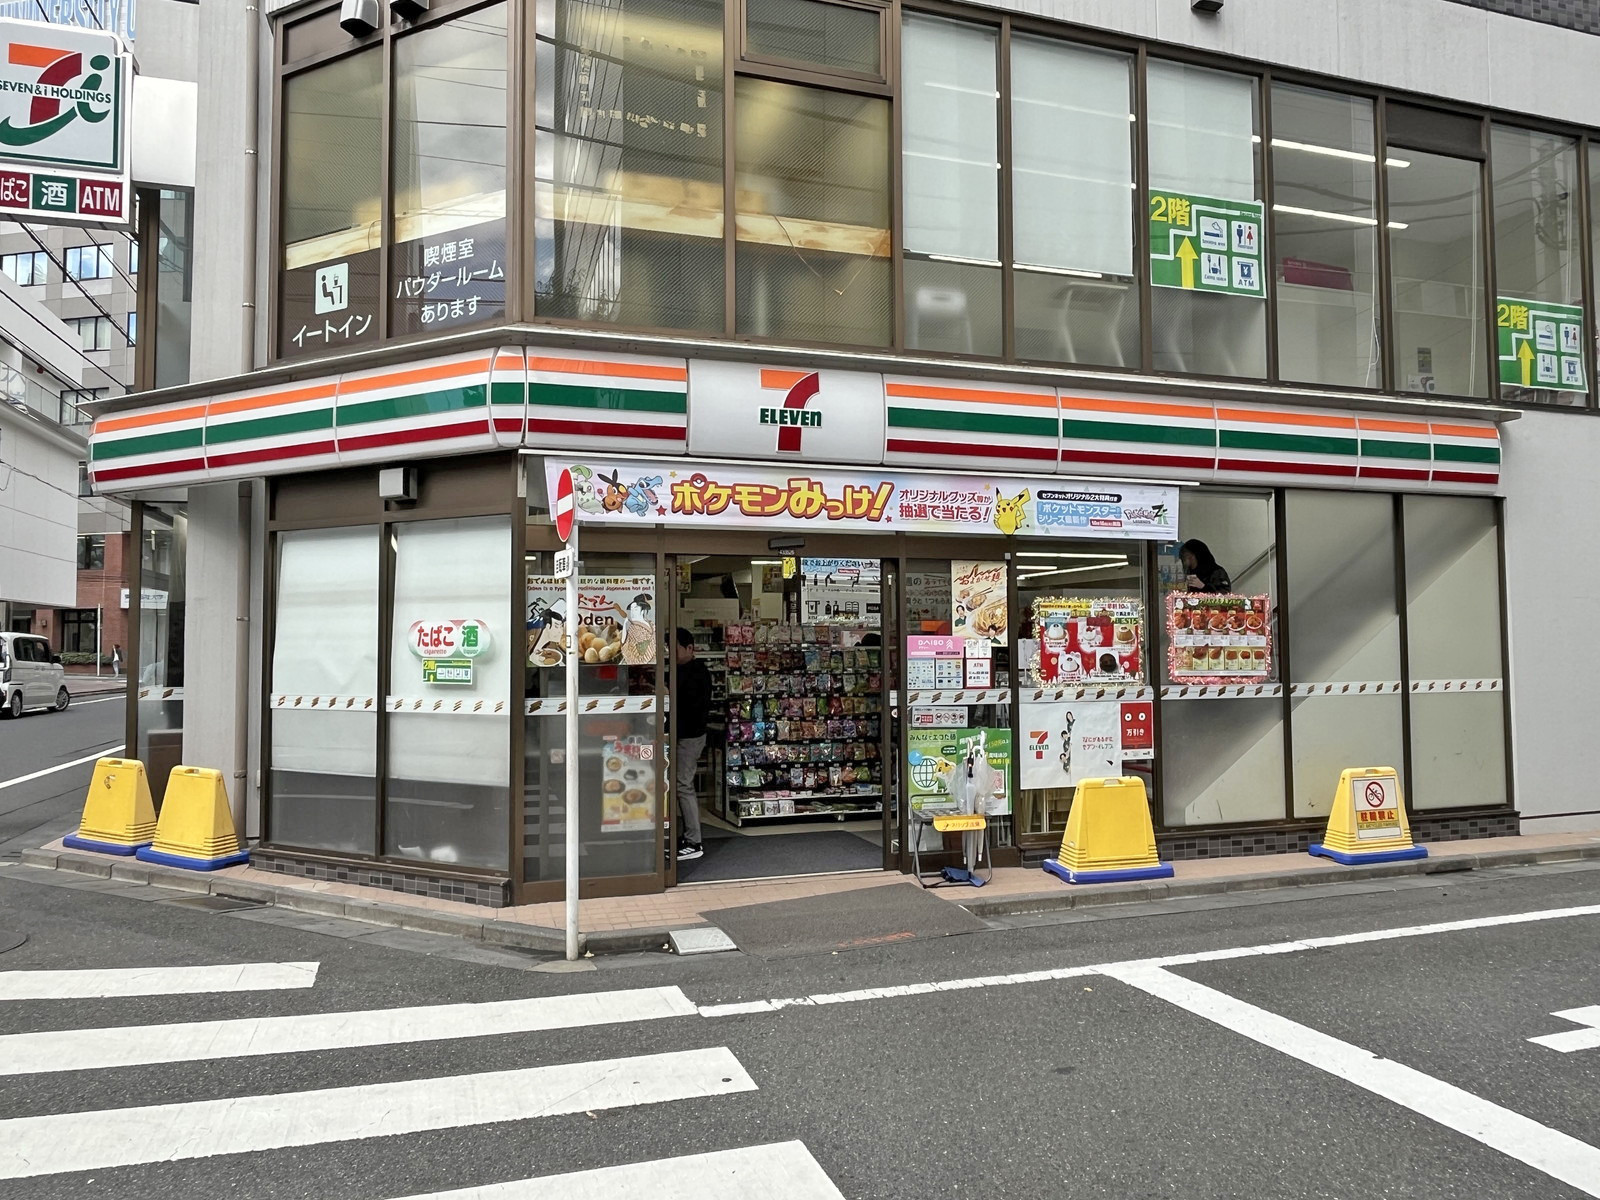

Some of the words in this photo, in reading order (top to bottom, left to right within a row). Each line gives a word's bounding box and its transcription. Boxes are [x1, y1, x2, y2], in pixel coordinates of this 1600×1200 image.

[51, 87, 111, 104] HOLDINGS
[41, 181, 68, 207] 酒
[81, 186, 120, 212] ATM
[1150, 196, 1190, 227] 2階
[424, 238, 475, 267] 喫煙室
[396, 260, 504, 299] パウダールーム
[1238, 279, 1254, 287] ATM
[420, 295, 482, 324] あります
[1498, 304, 1529, 331] 2階
[292, 314, 372, 348] イートイン
[671, 473, 895, 521] ポケモンみっけ!
[899, 503, 991, 521] 抽選で当たる!
[578, 577, 654, 585] 統的な鍋料理の一種です。
[417, 625, 454, 647] たばこ
[462, 625, 479, 647] 酒
